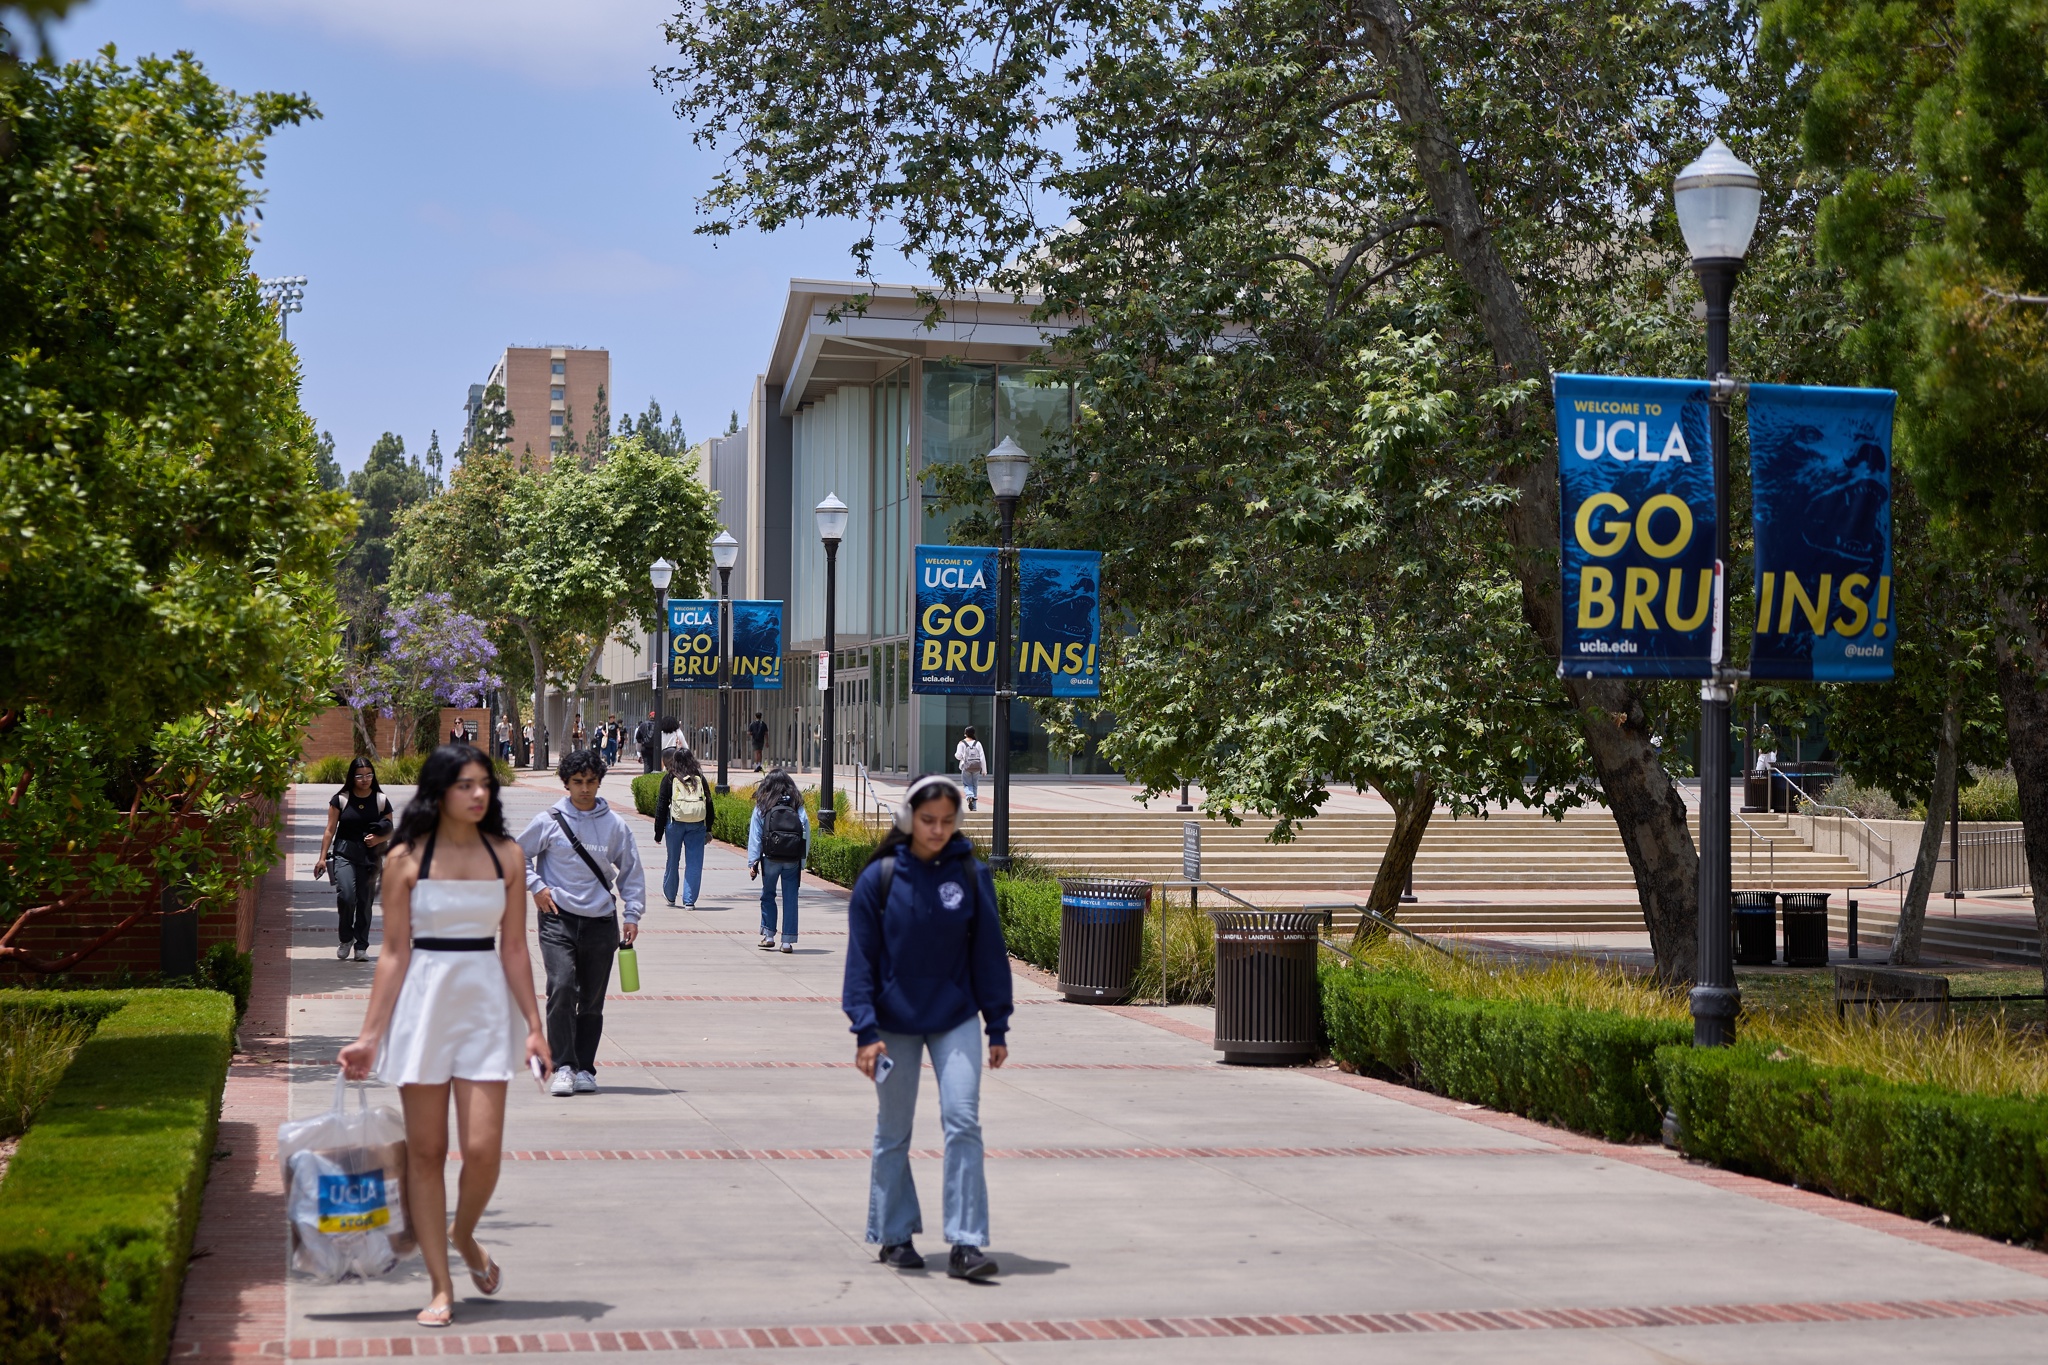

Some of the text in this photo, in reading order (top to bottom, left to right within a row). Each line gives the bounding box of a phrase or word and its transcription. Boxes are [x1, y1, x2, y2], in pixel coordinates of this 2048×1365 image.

[1574, 401, 1662, 416] WELCOME TO
[1575, 418, 1693, 463] UCLA
[1575, 491, 1694, 559] GO
[924, 567, 987, 589] UCLA
[1577, 566, 1713, 632] BRU
[1756, 571, 1891, 638] INS!
[674, 612, 712, 625] UCLA
[922, 603, 985, 636] GO
[673, 633, 712, 654] GO
[1580, 639, 1638, 653] ucla.edu
[1844, 644, 1884, 658] @ucla
[673, 655, 719, 676] BRU
[732, 656, 781, 676] INS!
[921, 639, 996, 672] BRU
[1018, 641, 1097, 675] INS!
[922, 675, 955, 683] ucla.edu
[1069, 677, 1094, 686] @ucla
[1080, 899, 1100, 907] RECYCLE
[1222, 933, 1243, 941] LANDFILL
[1248, 933, 1275, 941] LANDFILL
[1283, 933, 1306, 941] LANDFILL
[330, 1181, 377, 1204] UCLA
